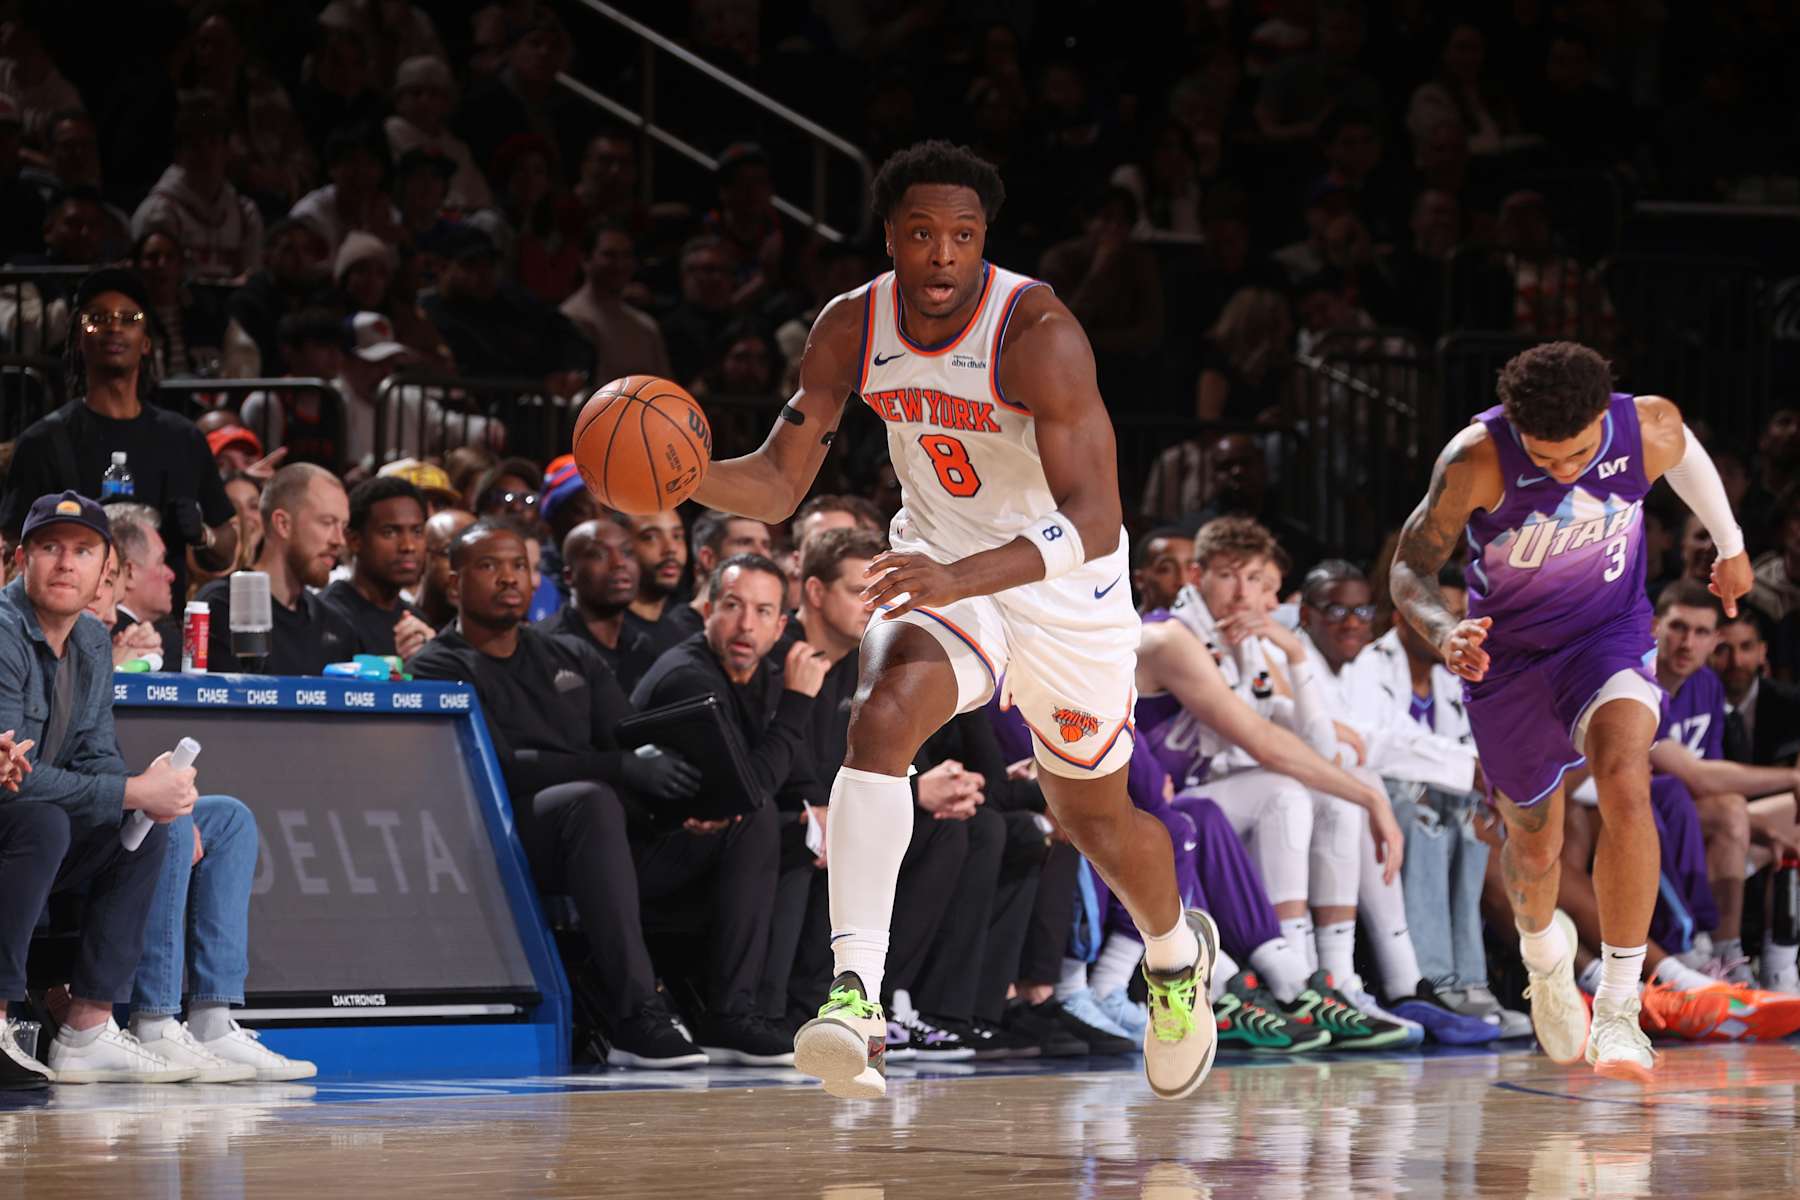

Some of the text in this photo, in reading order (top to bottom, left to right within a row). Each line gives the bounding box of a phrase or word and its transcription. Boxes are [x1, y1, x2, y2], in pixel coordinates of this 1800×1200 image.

[951, 358, 987, 369] abu dhabi
[864, 387, 1002, 433] NEW YORK
[918, 434, 982, 497] 8
[1597, 455, 1631, 480] LVT
[1042, 525, 1063, 541] 8
[1508, 502, 1637, 568] UTAH
[1603, 534, 1628, 582] 3
[147, 684, 178, 701] CHASE
[197, 687, 228, 703] CHASE
[247, 689, 278, 705] CHASE
[296, 690, 327, 706] CHASE
[344, 691, 375, 707] CHASE
[392, 693, 422, 709] CHASE
[439, 693, 469, 709] CHASE
[331, 994, 386, 1007] DAKTRONICS
